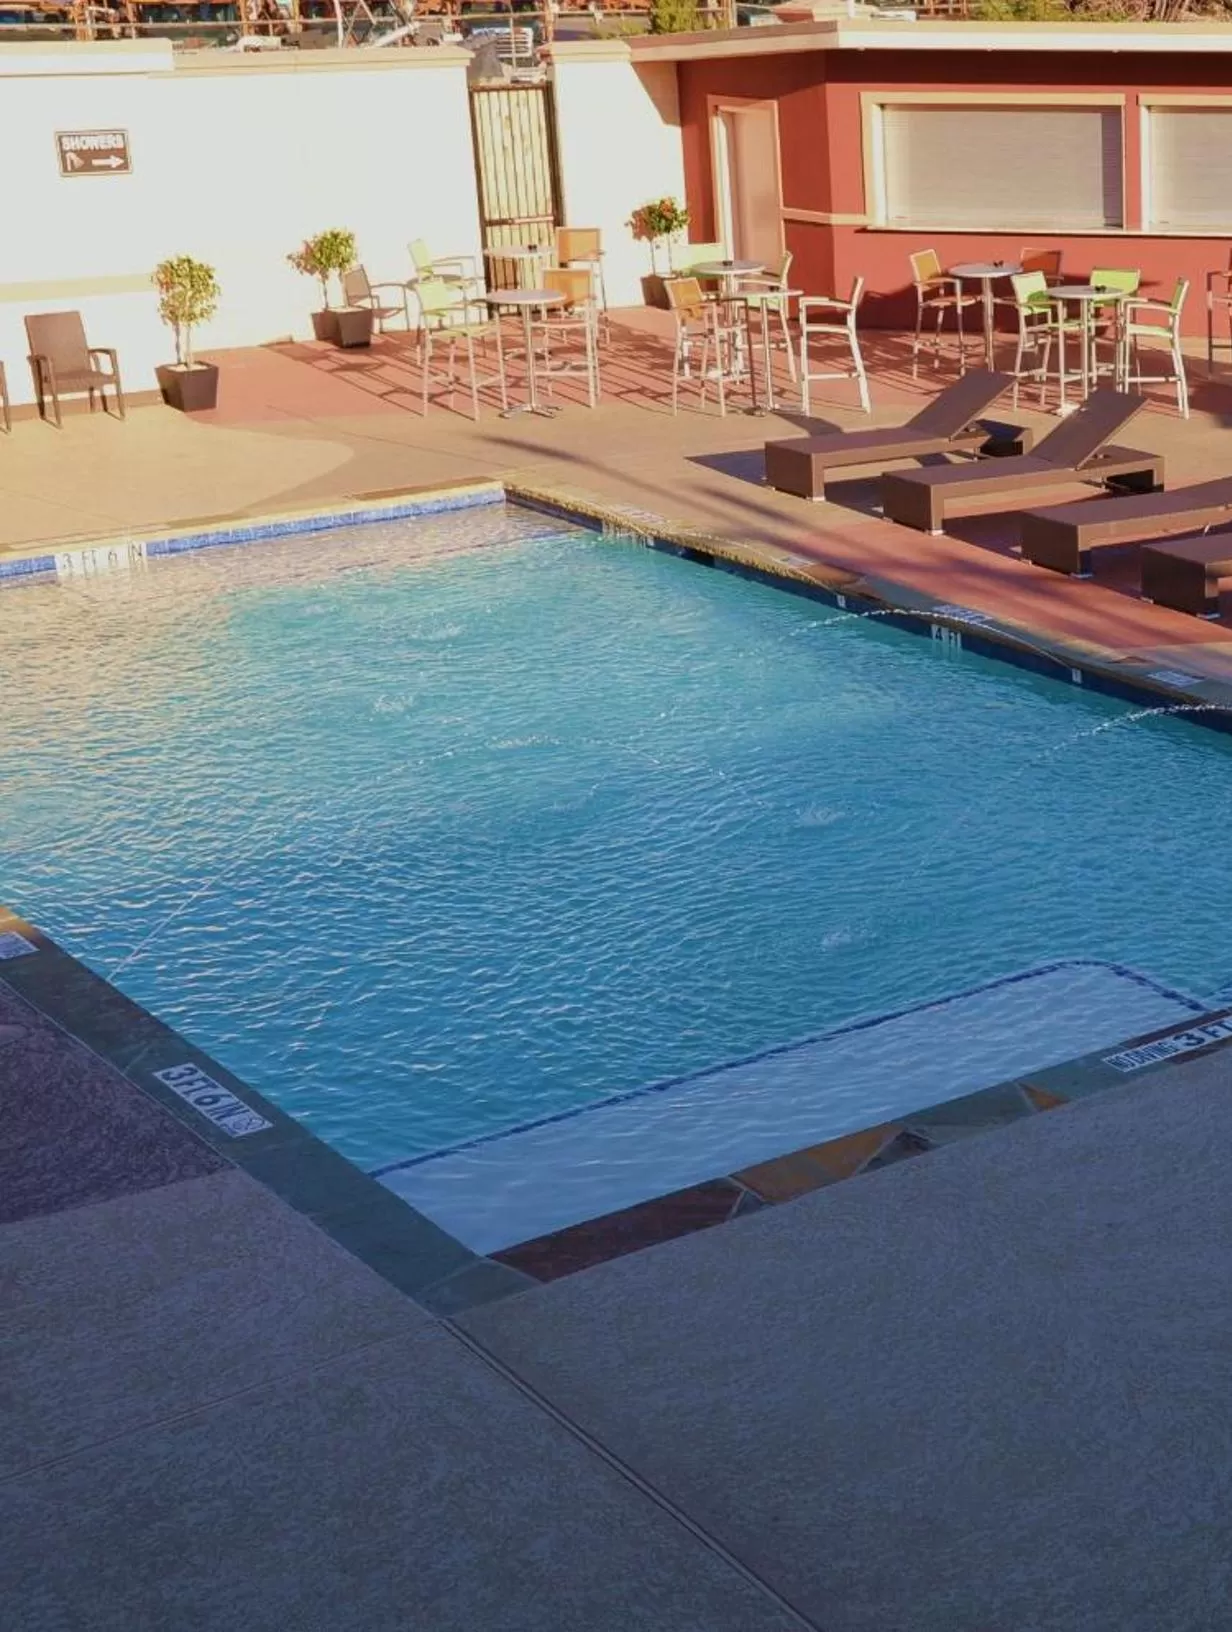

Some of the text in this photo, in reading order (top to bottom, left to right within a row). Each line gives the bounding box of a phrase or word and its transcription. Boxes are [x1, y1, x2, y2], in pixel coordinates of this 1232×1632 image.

[61, 133, 124, 151] SHOWERS
[1172, 1032, 1205, 1047] 3
[161, 1067, 199, 1080] 3
[193, 1094, 233, 1106] 6
[204, 1101, 250, 1120] IN
